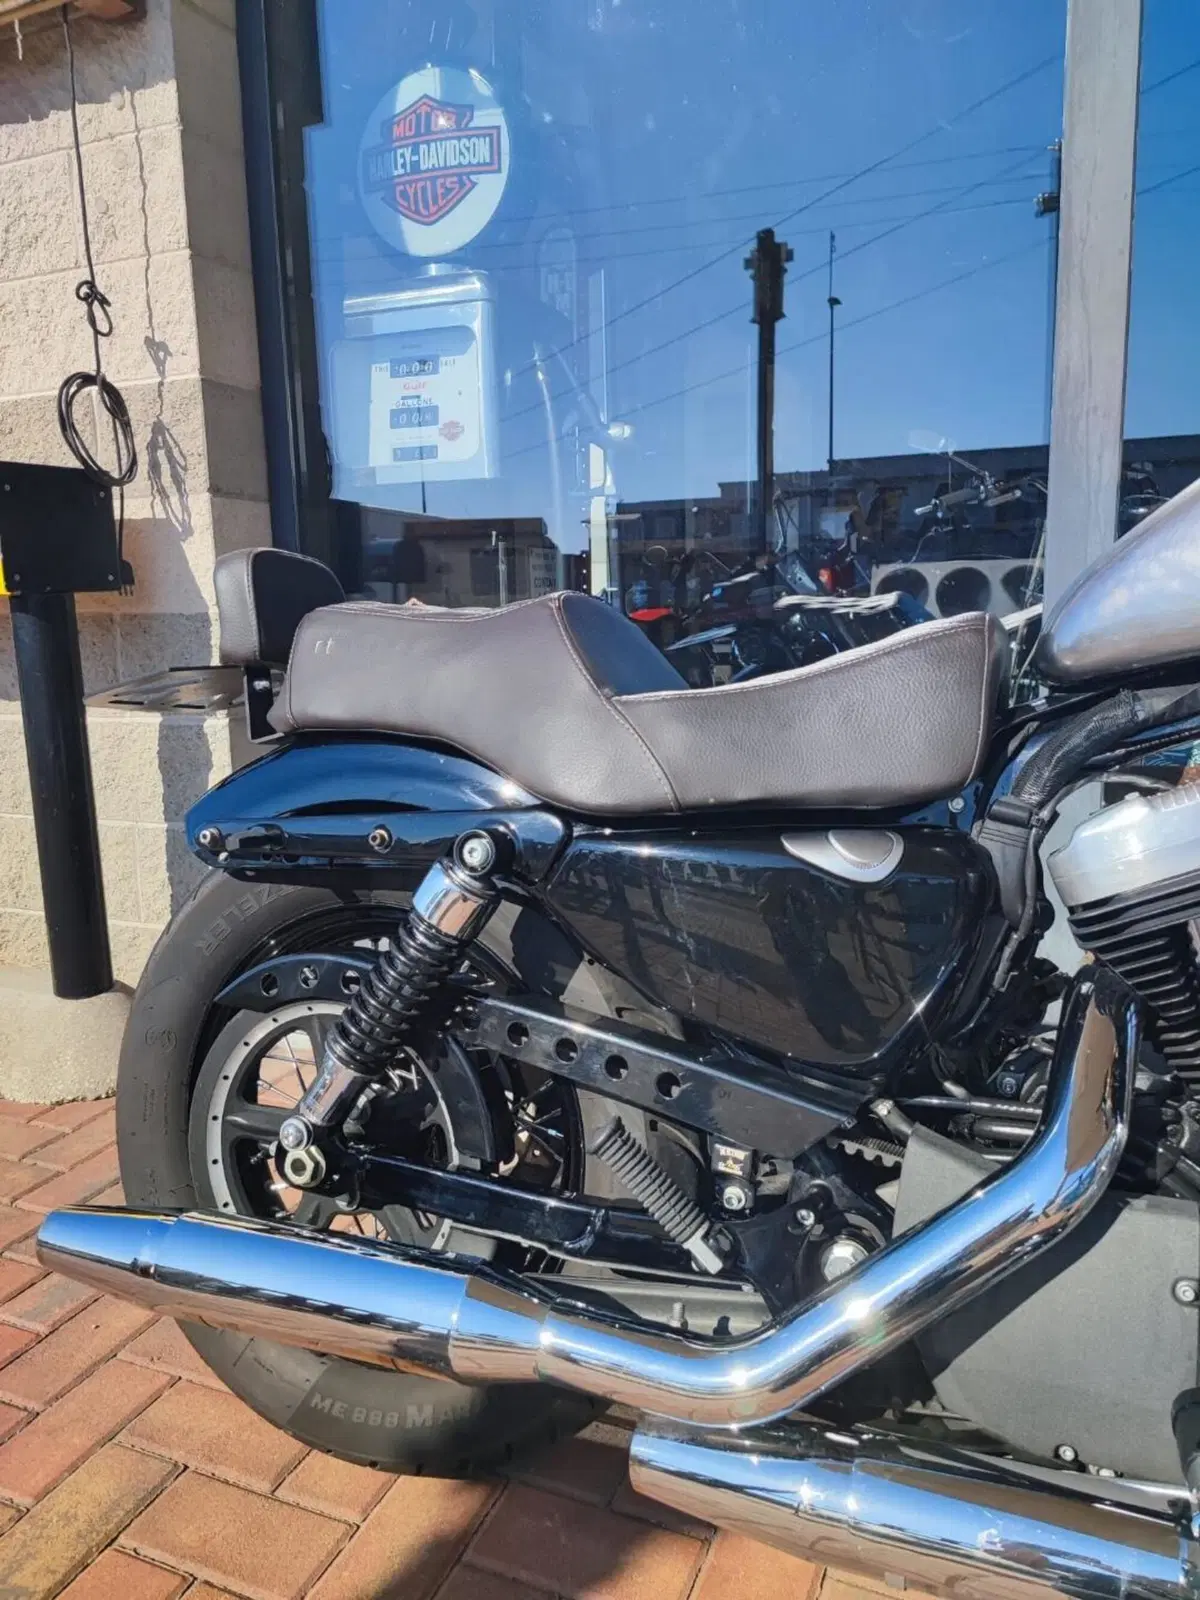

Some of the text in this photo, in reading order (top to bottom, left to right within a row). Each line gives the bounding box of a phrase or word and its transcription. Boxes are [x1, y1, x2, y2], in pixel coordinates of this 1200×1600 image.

[369, 136, 491, 181] HARLEY-DAVIDSON
[395, 176, 459, 216] CYCLES
[310, 1392, 348, 1419] ME
